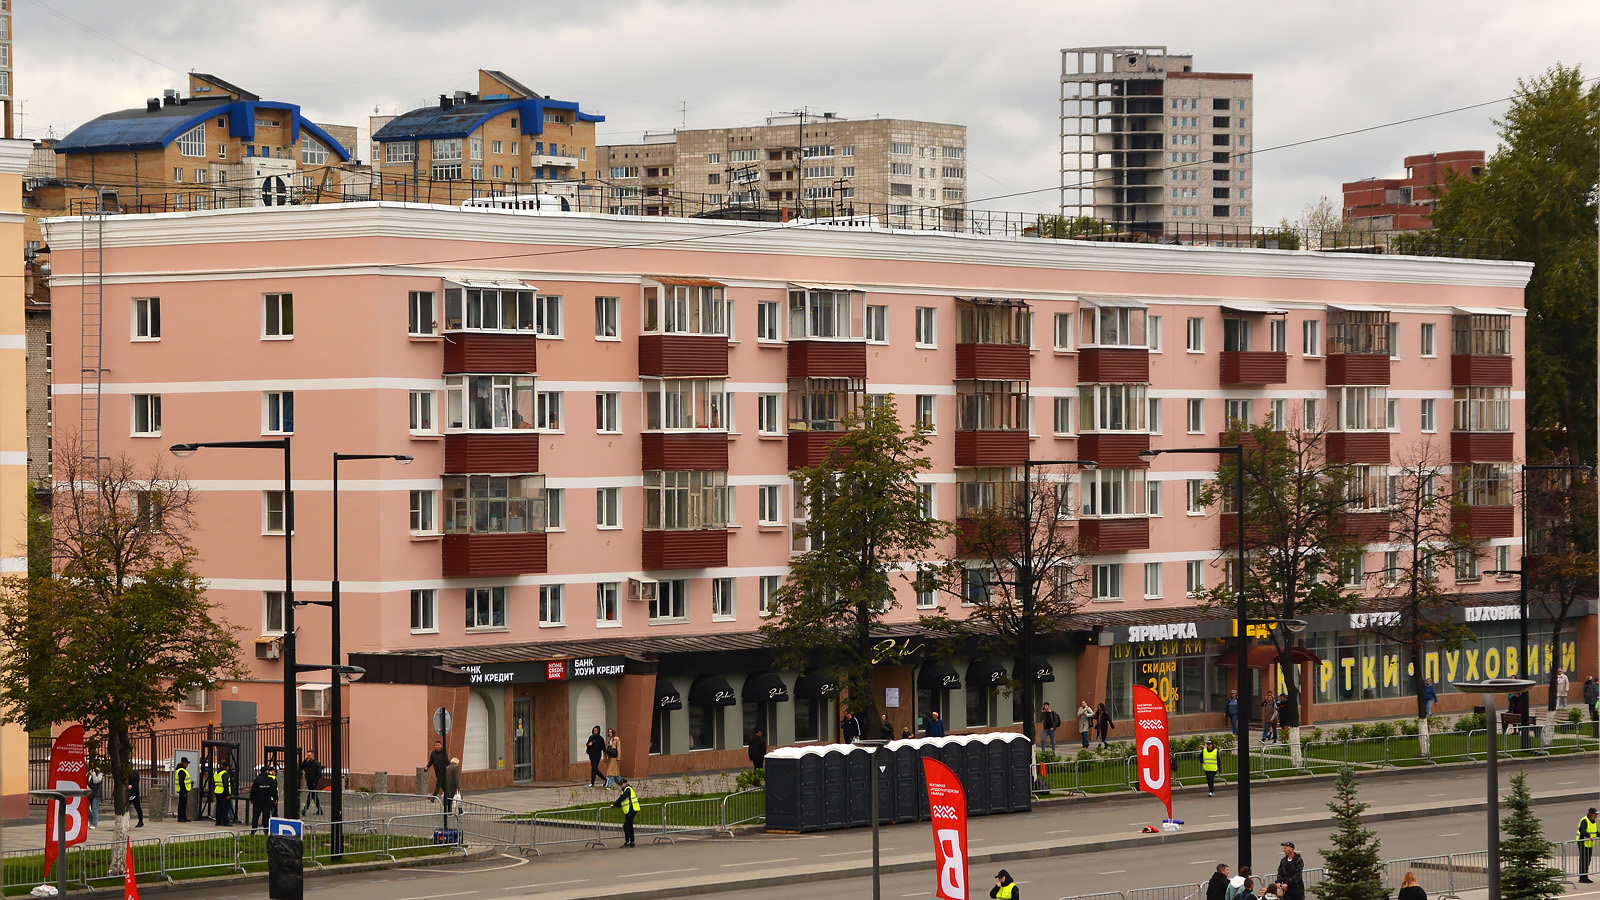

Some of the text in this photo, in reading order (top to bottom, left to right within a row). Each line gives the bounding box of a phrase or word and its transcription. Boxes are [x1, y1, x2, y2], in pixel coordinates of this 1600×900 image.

[1465, 605, 1529, 622] ПУХОВИК
[1128, 622, 1198, 642] ЯРМАРКА
[1114, 640, 1202, 658] ПУХОВИКИ
[575, 658, 593, 668] БАНК
[575, 665, 625, 676] ХОУМ КРЕДИТ
[1142, 660, 1177, 674] скидка
[470, 672, 514, 683] УМ КРЕДИТ
[1277, 654, 1398, 696] КРТКИ
